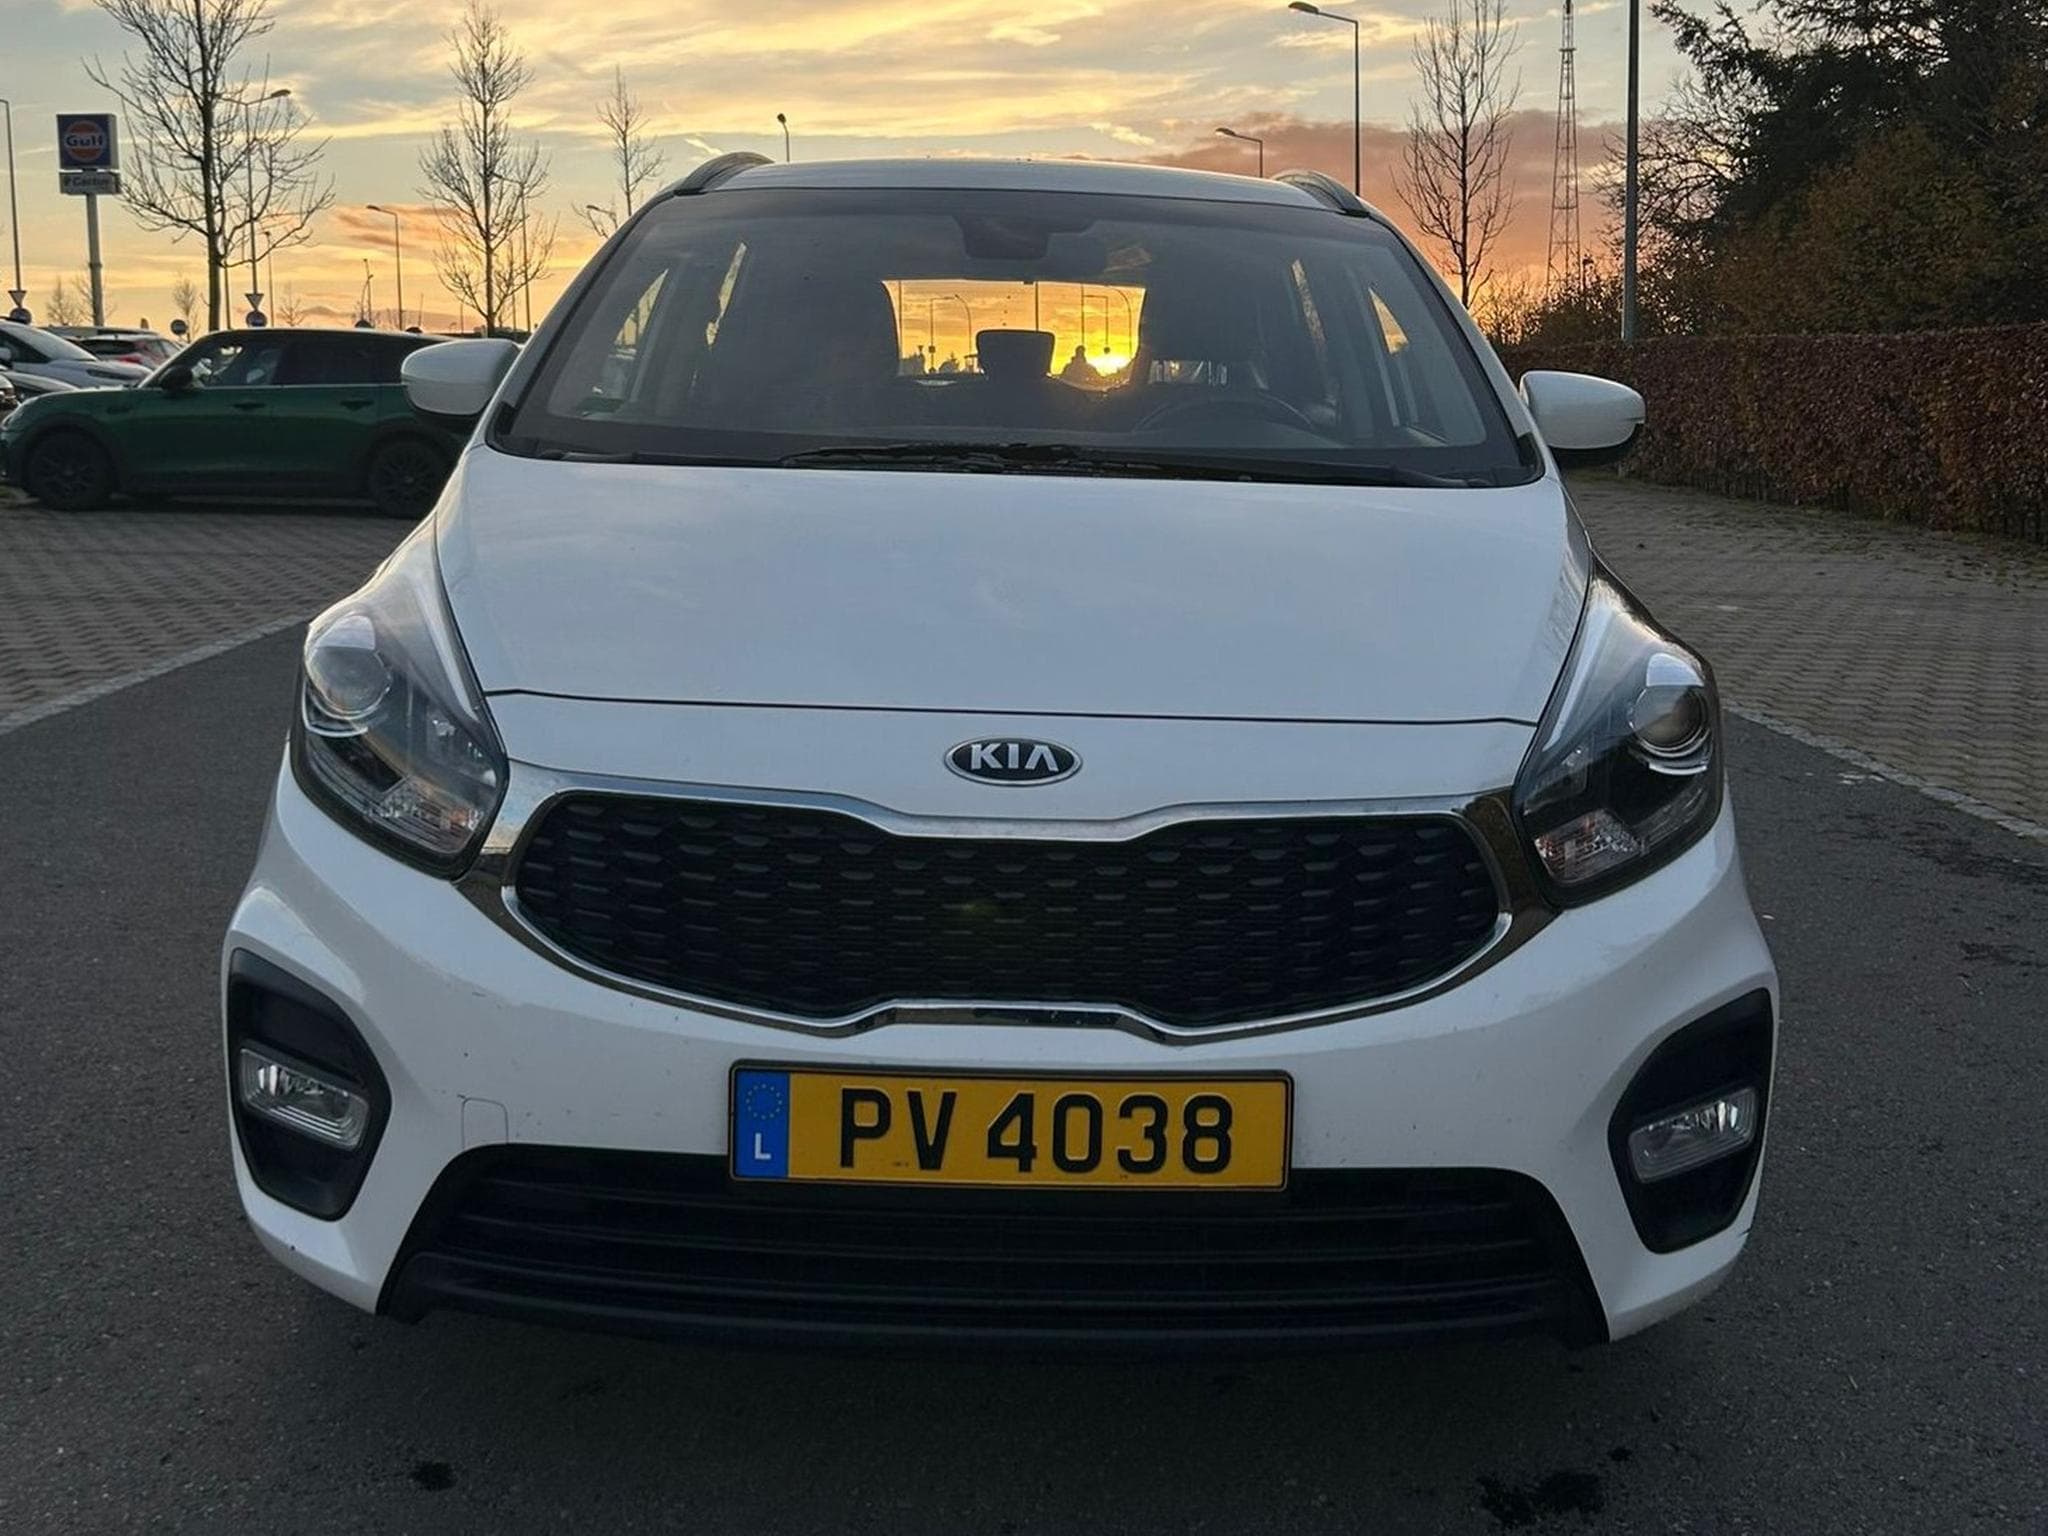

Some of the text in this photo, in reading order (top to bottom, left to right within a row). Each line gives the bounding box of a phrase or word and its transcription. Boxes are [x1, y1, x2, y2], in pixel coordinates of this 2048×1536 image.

[65, 134, 104, 147] Gulf
[970, 742, 1060, 772] KIA
[839, 1087, 1233, 1174] PV 4038
[754, 1132, 772, 1160] L
